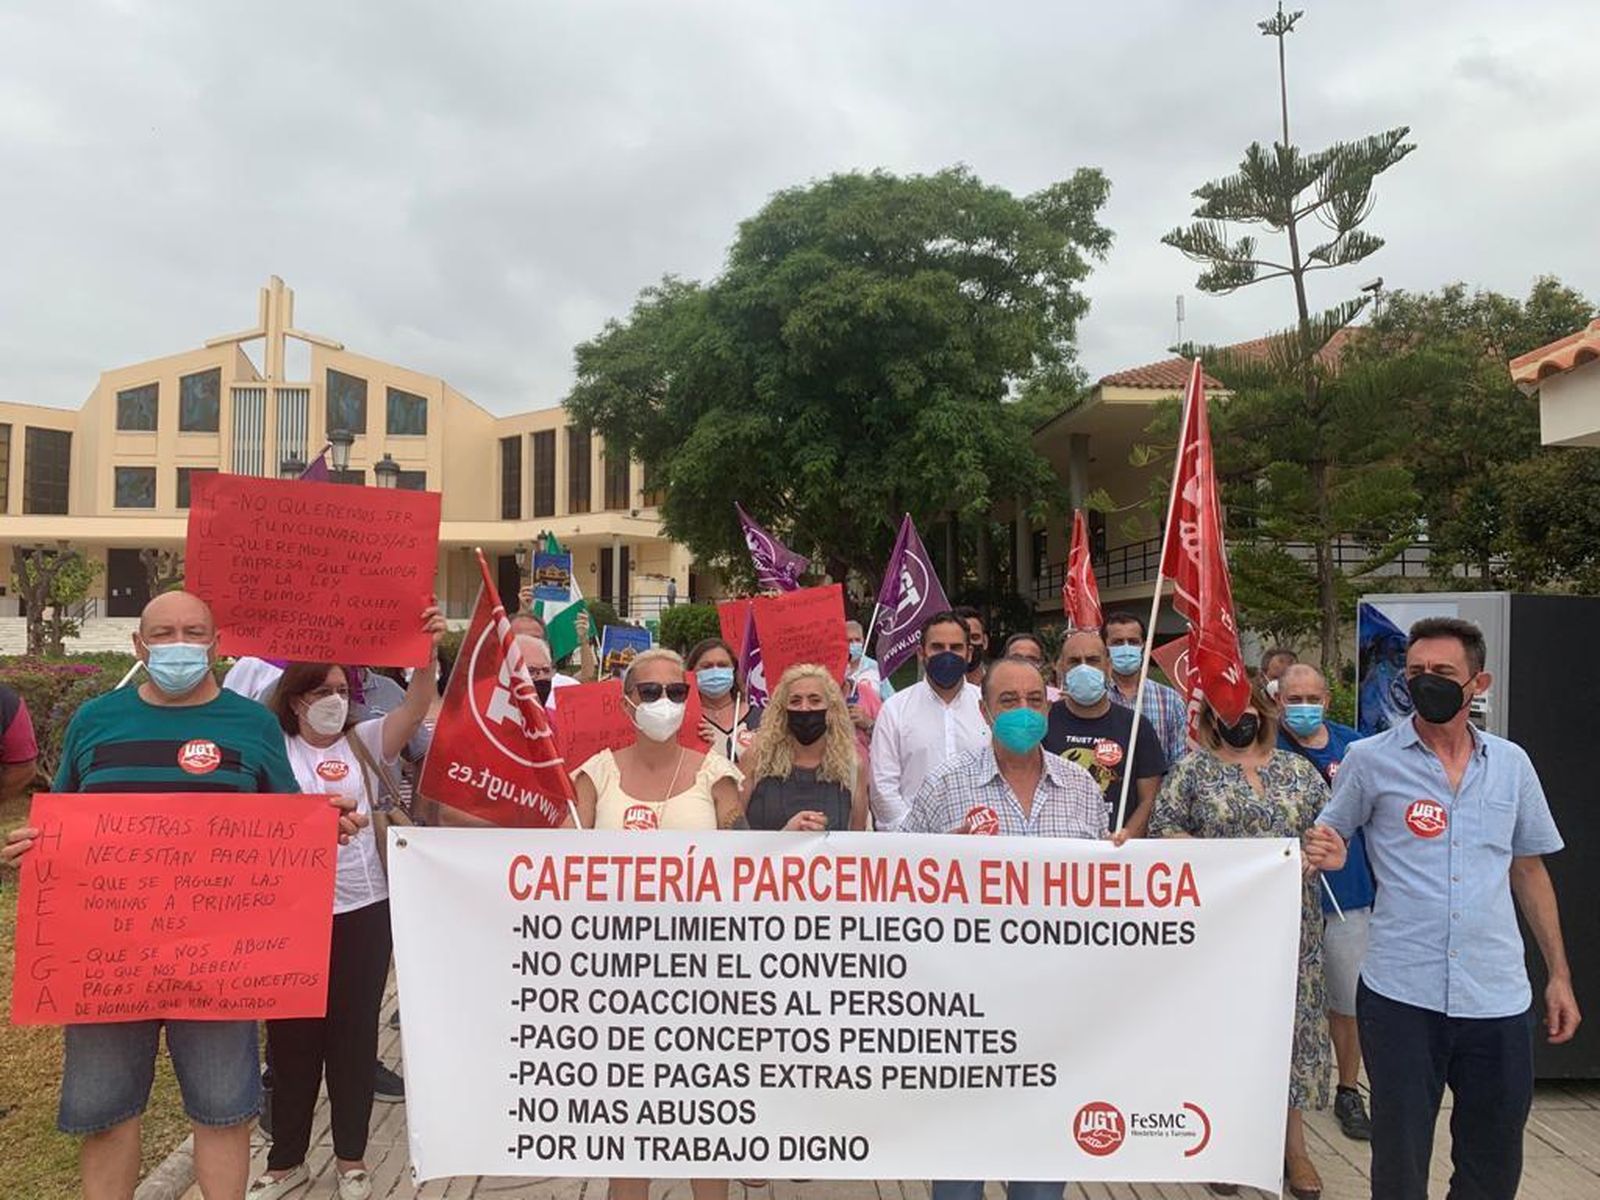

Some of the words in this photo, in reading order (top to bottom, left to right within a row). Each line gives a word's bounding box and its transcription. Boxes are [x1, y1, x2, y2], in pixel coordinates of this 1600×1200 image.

[386, 511, 414, 523] SER
[347, 551, 383, 565] UNA
[316, 563, 349, 576] QUE
[229, 573, 260, 586] CON
[275, 573, 292, 586] LA
[310, 575, 342, 590] LEY
[329, 592, 340, 608] A
[347, 594, 400, 610] QUIEN
[230, 623, 265, 639] TOME
[273, 627, 332, 644] CARTAS
[360, 619, 399, 632] QUE
[267, 642, 336, 658] ASUNTO
[184, 742, 217, 757] UGT
[1066, 735, 1092, 745] TRUST
[1098, 742, 1119, 753] UGT
[627, 807, 654, 822] UGT
[1412, 802, 1445, 819] UGT
[95, 812, 194, 838] NUESTRAS
[208, 815, 298, 841] FAMILIAS
[85, 845, 197, 866] NECESITAN
[210, 847, 259, 864] PARA
[269, 846, 328, 869] VIVIR
[138, 876, 161, 890] SE
[174, 874, 235, 891] PAGUEN
[250, 873, 283, 888] LAS
[508, 845, 721, 902] CAFETERÍA
[733, 855, 968, 904] PARCEMASA
[979, 860, 1029, 906] EN
[1044, 862, 1200, 908] HUELGA
[84, 894, 149, 911] NOMINAS
[164, 893, 176, 911] A
[191, 891, 277, 914] PRIMERO
[30, 822, 63, 1014] HUELGA
[113, 916, 135, 932] DE
[151, 915, 188, 932] MES
[514, 915, 561, 939] -NO
[572, 916, 784, 941] CUMPLIMIENTO
[795, 916, 830, 940] DE
[841, 917, 943, 942] PLIEGO
[955, 919, 990, 943] DE
[1001, 920, 1194, 945] CONDICIONES
[140, 947, 160, 961] SE
[175, 943, 211, 960] NOS
[232, 936, 291, 957] ABONE
[85, 966, 105, 979] LO
[114, 965, 143, 978] QUE
[152, 963, 176, 977] NOS
[513, 952, 561, 975] -NO
[571, 953, 706, 977] CUMPLEN
[718, 954, 751, 978] EL
[761, 953, 906, 978] CONVENIO
[82, 981, 136, 999] PAGAS
[145, 978, 203, 994] EXTRAS
[216, 977, 225, 996] Y
[231, 971, 321, 990] CONCEPTOS
[75, 1001, 91, 1016] DE
[158, 999, 182, 1010] QUE
[188, 996, 213, 1009] HAN
[218, 997, 276, 1011] QUITADO
[512, 988, 579, 1013] -POR
[589, 990, 776, 1015] COACCIONES
[785, 991, 821, 1015] AL
[831, 991, 984, 1017] PERSONAL
[511, 1025, 598, 1050] -PAGO
[609, 1027, 644, 1050] DE
[655, 1027, 829, 1053] CONCEPTOS
[841, 1028, 1016, 1053] PENDIENTES
[510, 1061, 597, 1086] -PAGO
[608, 1063, 644, 1087] DE
[655, 1063, 749, 1087] PAGAS
[761, 1064, 871, 1089] EXTRAS
[883, 1064, 1056, 1089] PENDIENTES
[509, 1098, 558, 1122] -NO
[569, 1099, 628, 1123] MAS
[637, 1100, 755, 1124] ABUSOS
[1131, 1113, 1186, 1129] FeSMC
[1079, 1110, 1119, 1133] UGT
[508, 1135, 576, 1159] -POR
[587, 1136, 623, 1160] UN
[635, 1137, 769, 1161] TRABAJO
[780, 1136, 868, 1161] DIGNO
